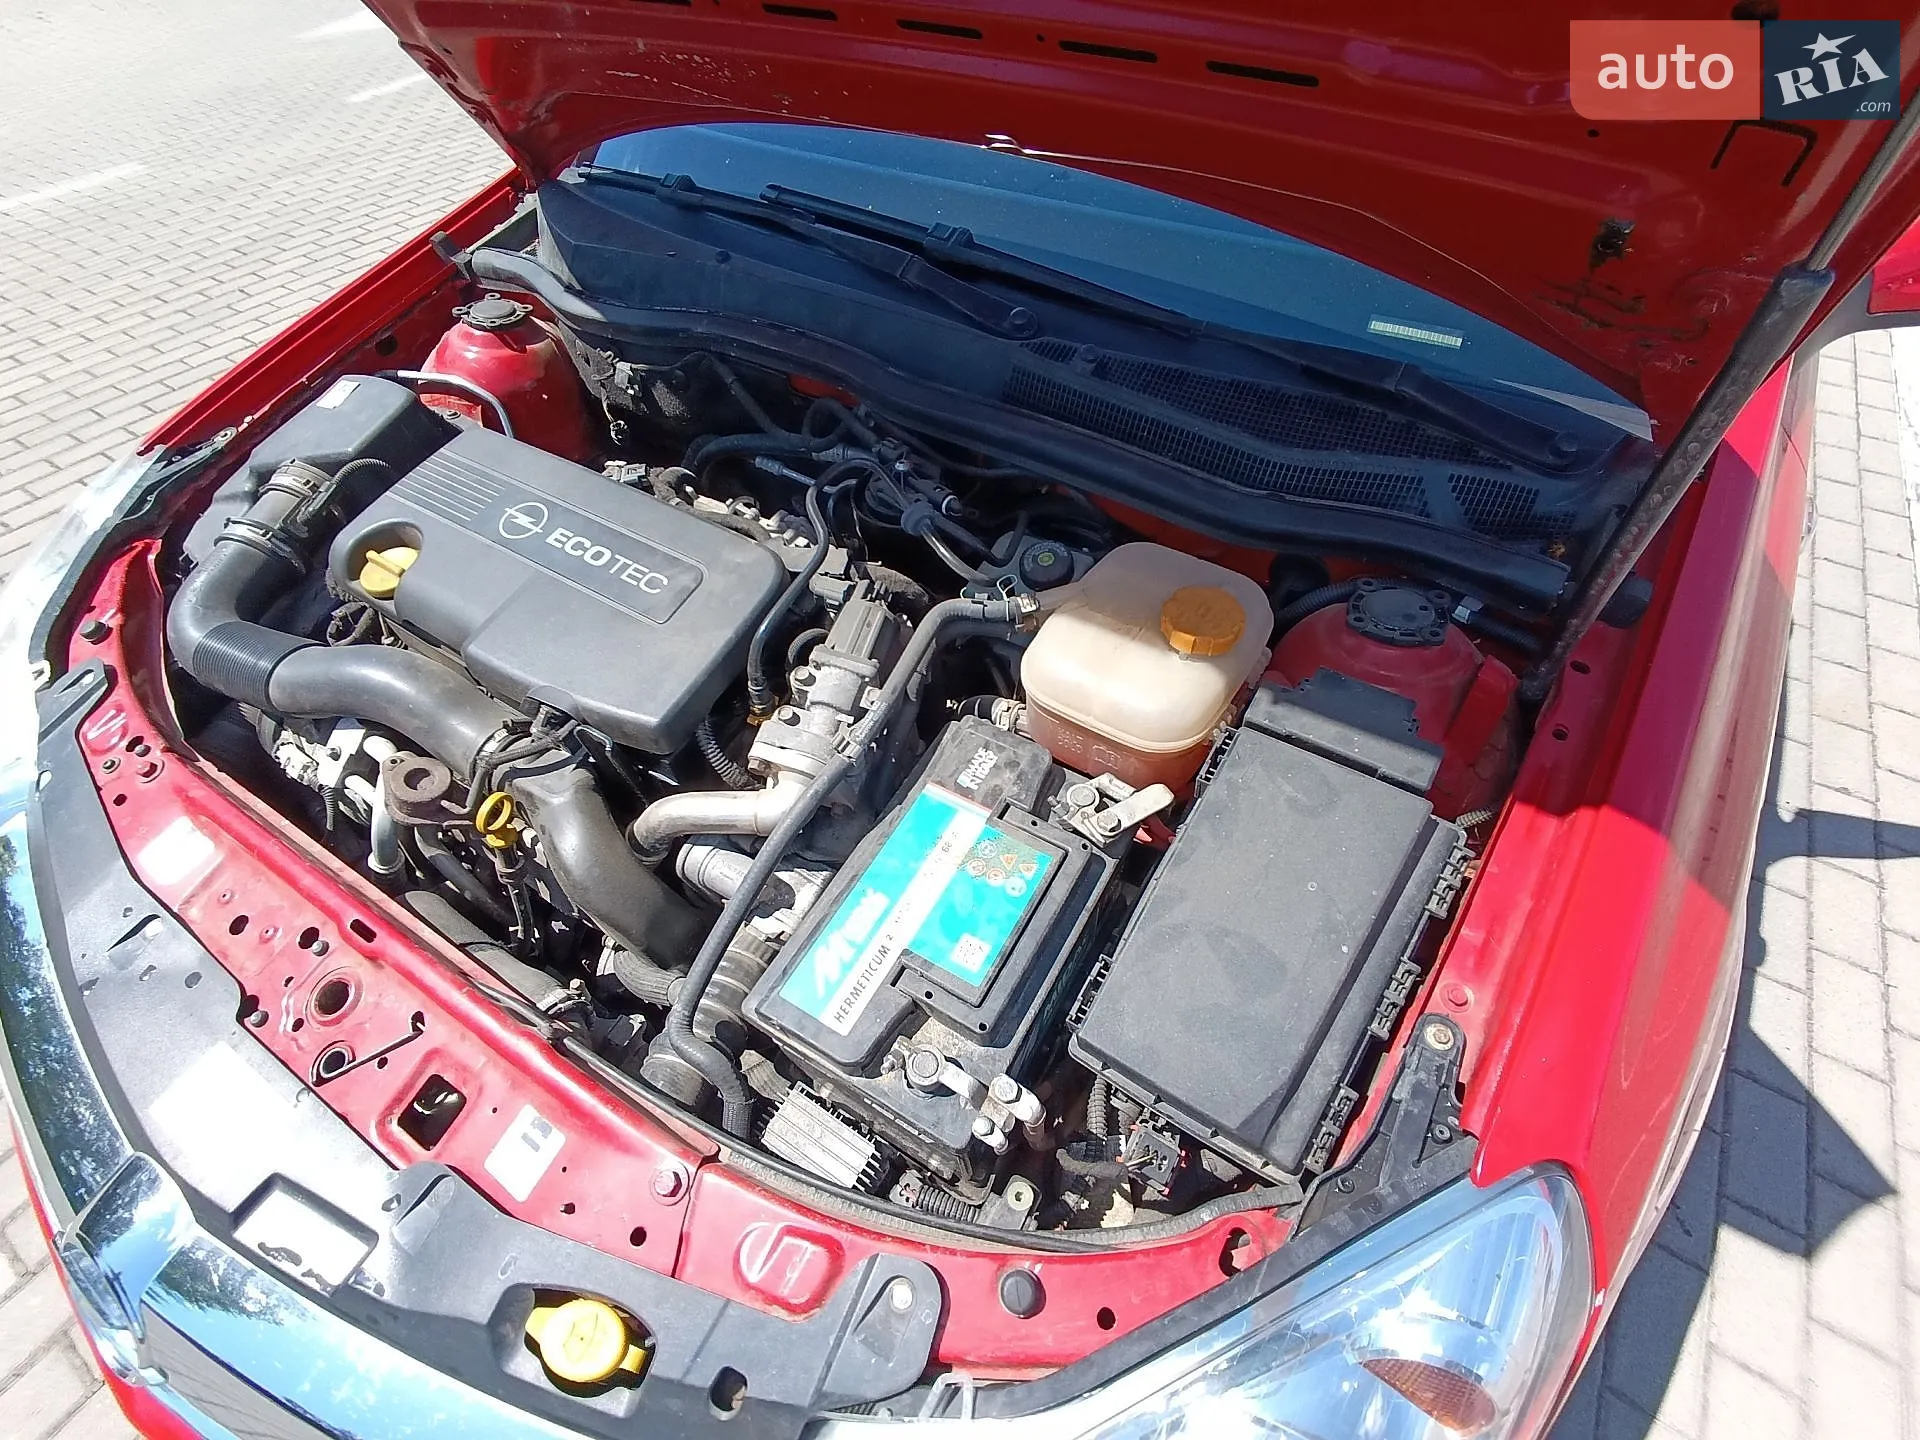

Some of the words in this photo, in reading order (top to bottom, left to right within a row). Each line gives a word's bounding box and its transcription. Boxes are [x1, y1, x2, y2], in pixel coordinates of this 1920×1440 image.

[545, 527, 669, 594] ECOTEC
[963, 746, 988, 776] MADE
[833, 944, 892, 1024] HERMETICUM
